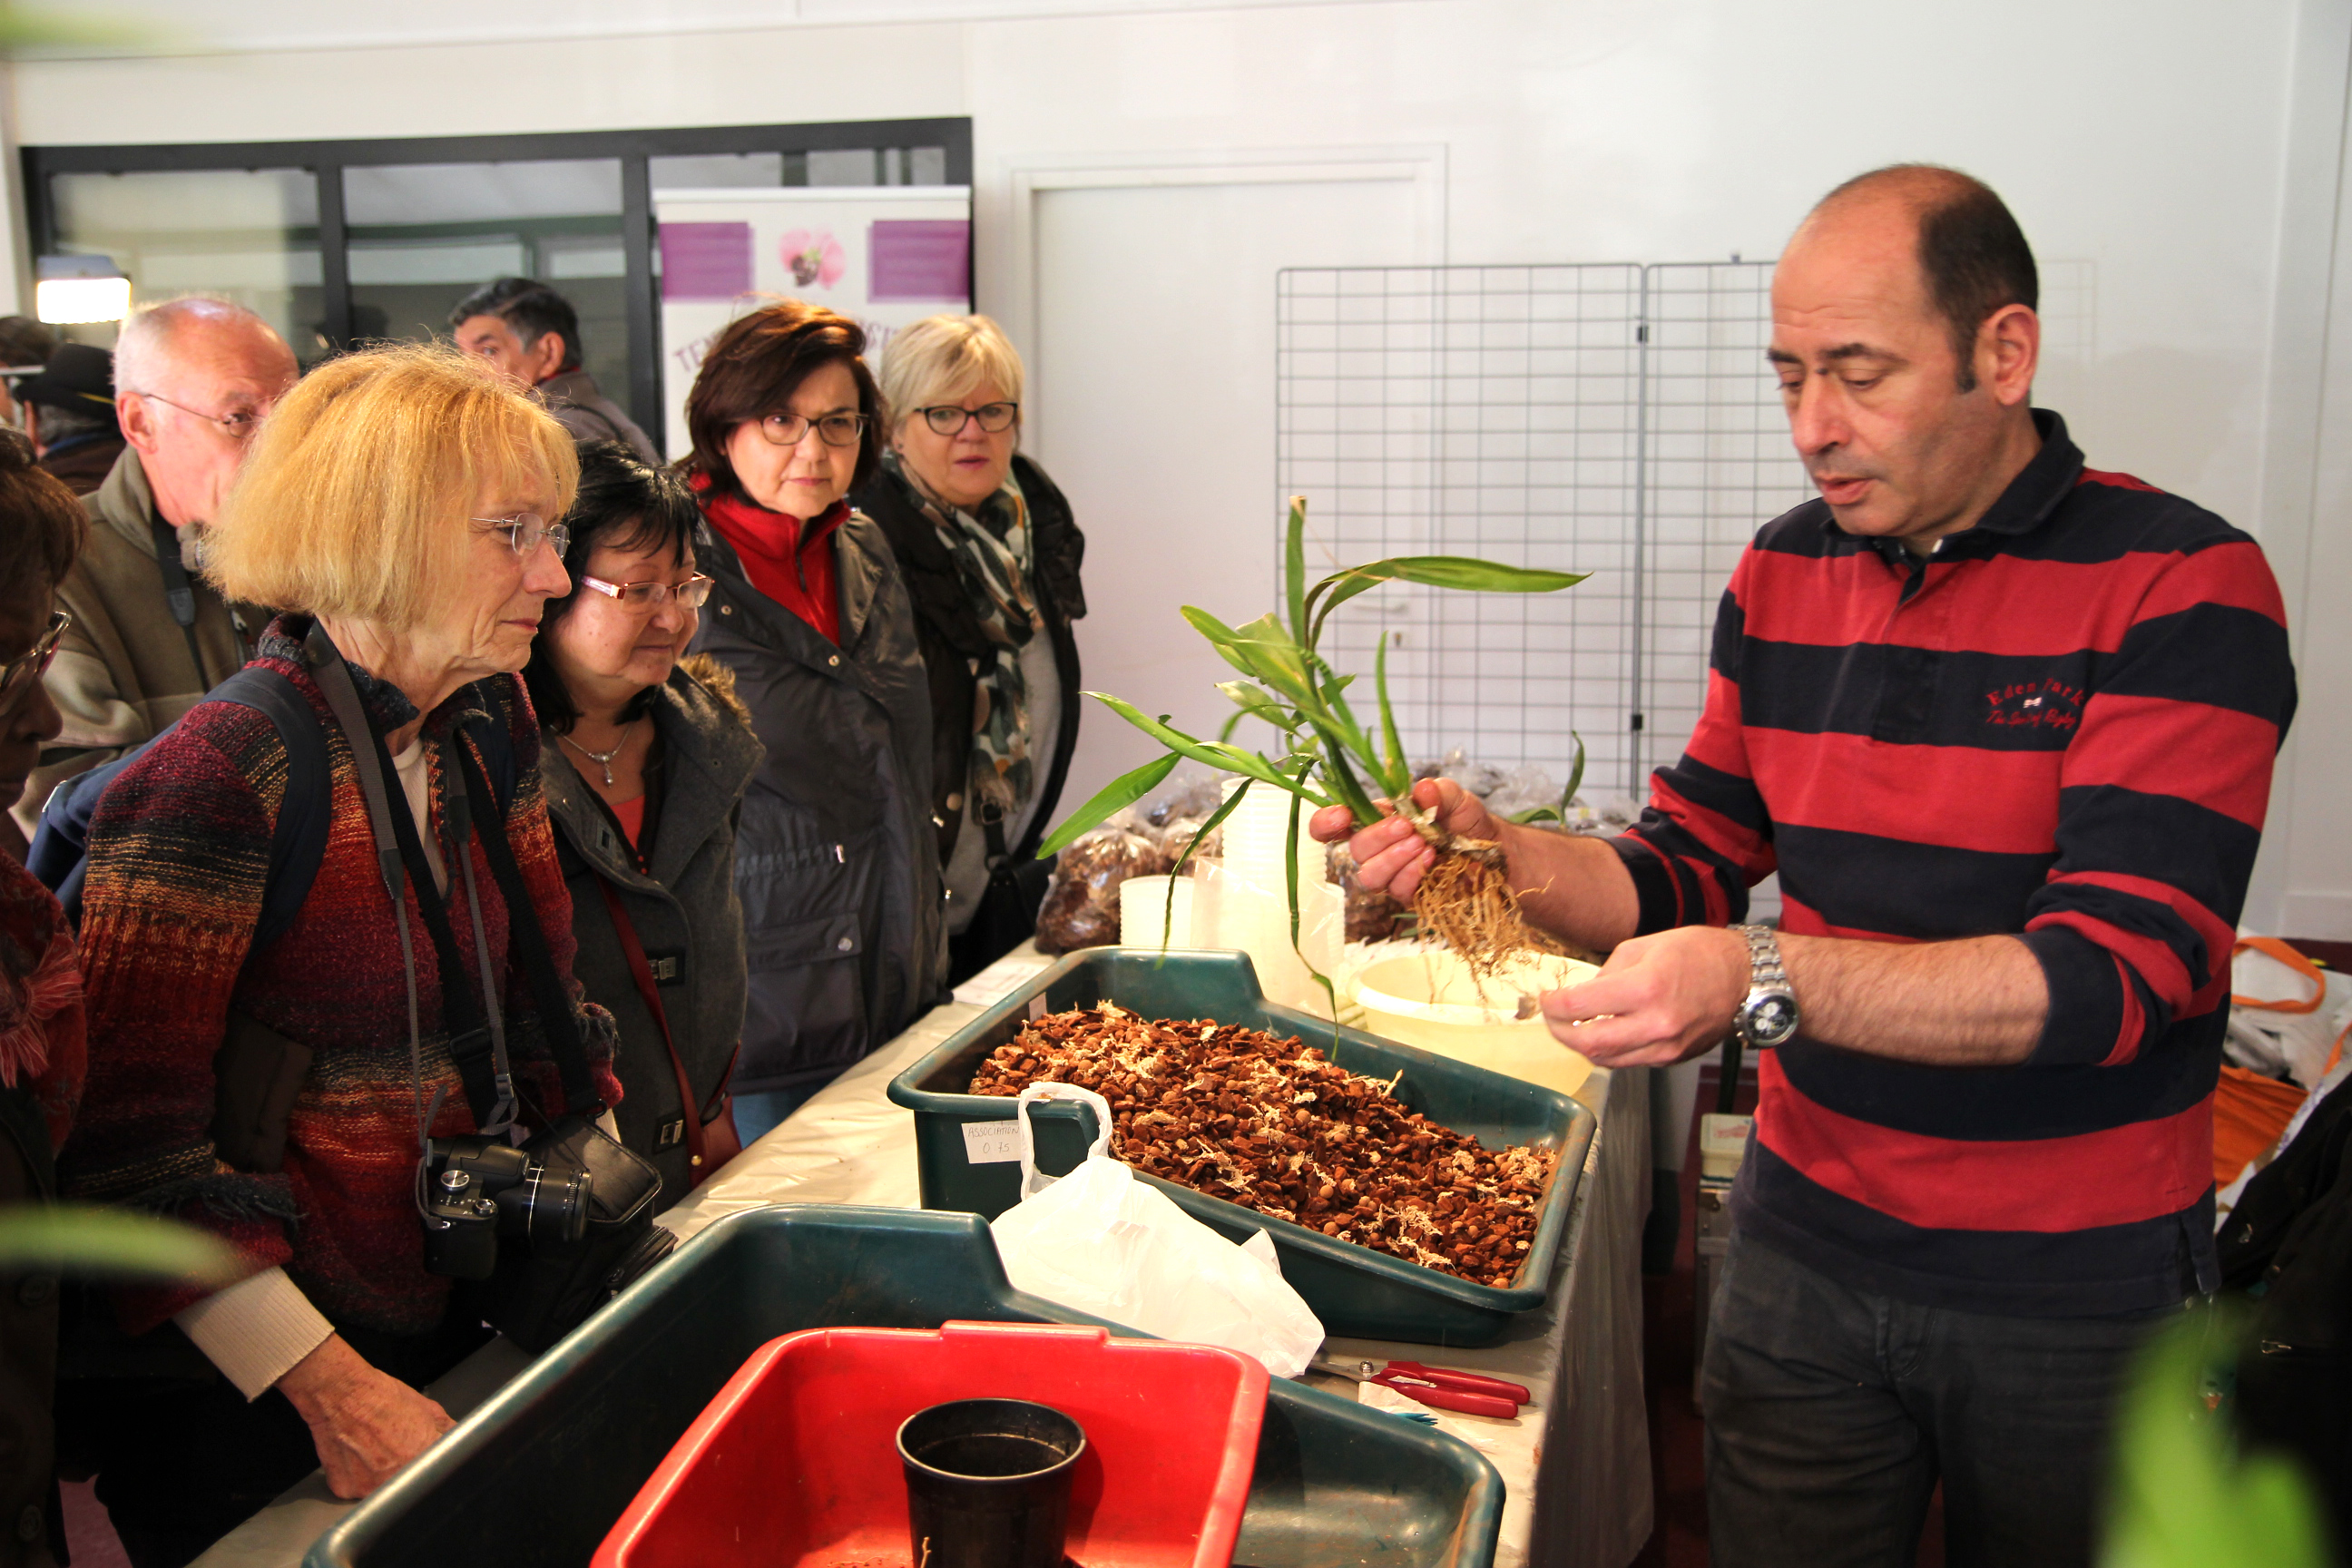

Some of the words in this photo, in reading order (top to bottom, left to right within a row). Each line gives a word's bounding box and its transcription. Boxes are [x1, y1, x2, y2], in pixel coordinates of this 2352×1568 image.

[1986, 682, 2036, 705] Eden
[2043, 678, 2083, 706] Park
[967, 1126, 1020, 1139] ASSOCIATION
